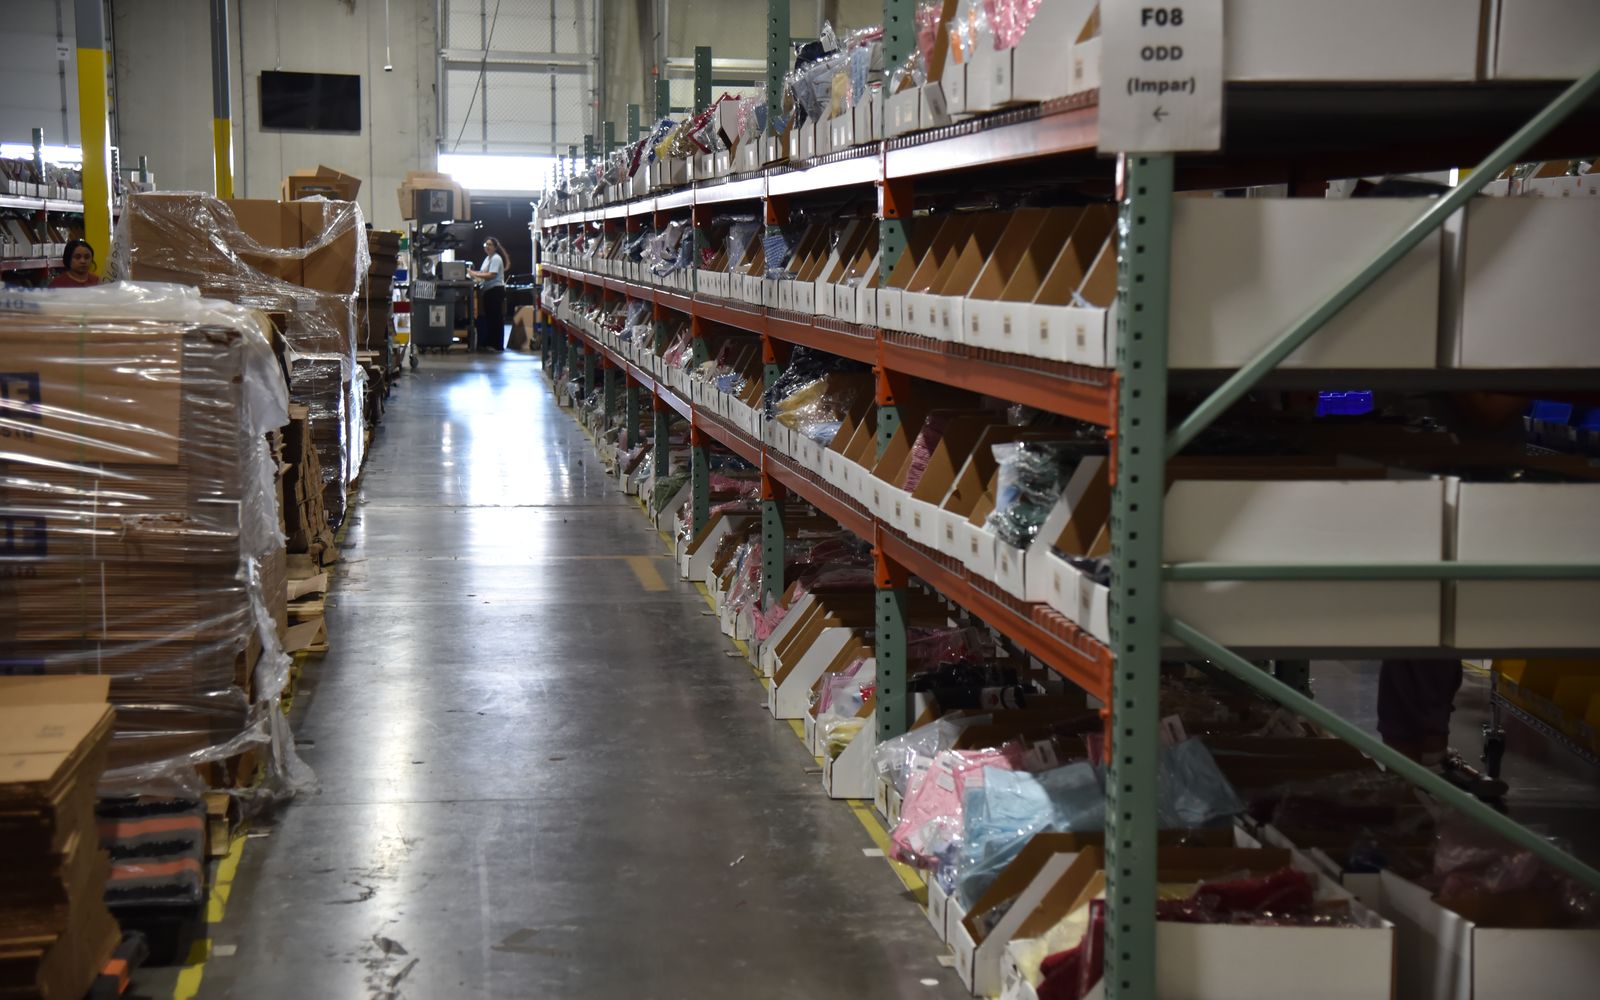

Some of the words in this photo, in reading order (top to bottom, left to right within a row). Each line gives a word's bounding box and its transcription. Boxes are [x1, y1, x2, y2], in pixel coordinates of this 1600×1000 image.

[1141, 8, 1184, 27] F08
[1141, 46, 1183, 61] ODD
[1127, 77, 1196, 96] (Impar)
